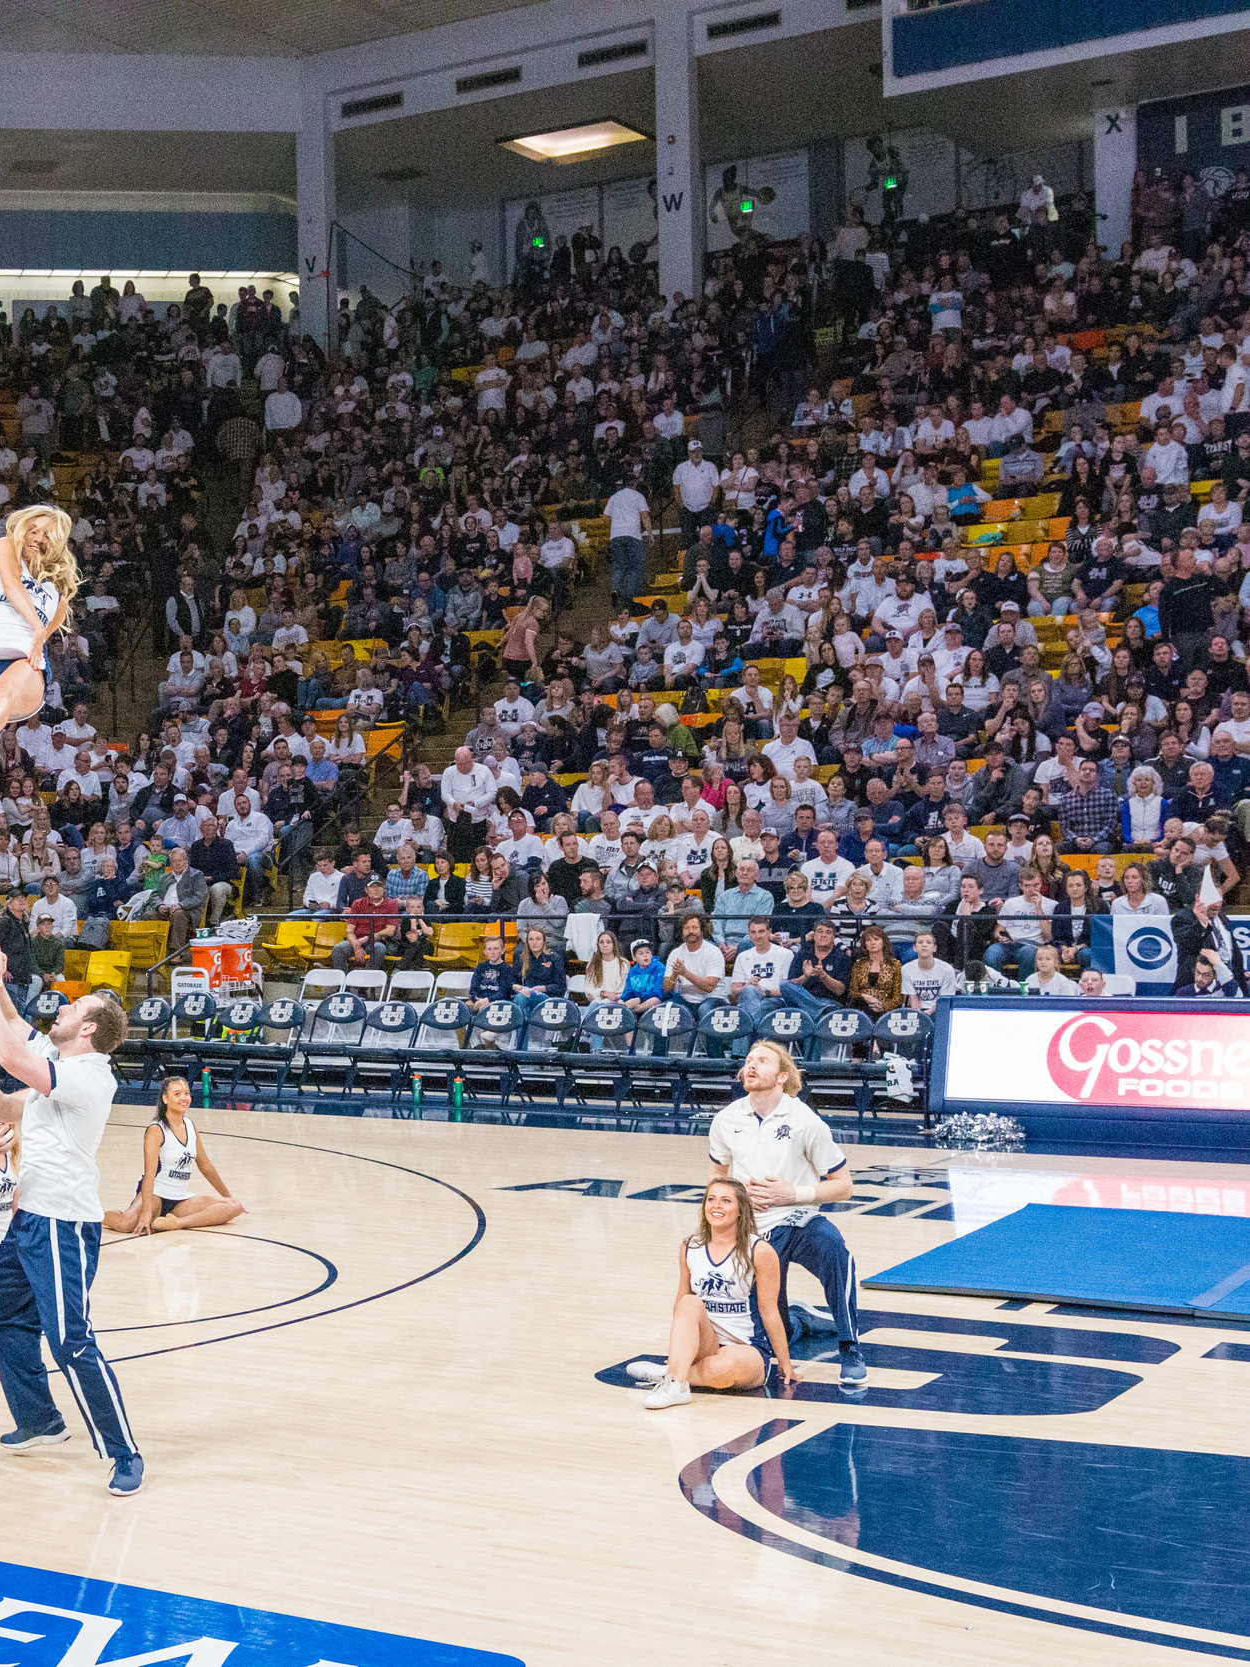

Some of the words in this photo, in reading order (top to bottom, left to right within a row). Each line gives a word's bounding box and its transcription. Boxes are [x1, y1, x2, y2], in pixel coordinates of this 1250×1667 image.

[1105, 113, 1122, 135] X
[662, 192, 684, 212] W
[304, 256, 316, 273] V
[745, 701, 757, 715] A
[811, 878, 838, 886] STATE
[751, 967, 775, 975] STATE
[1059, 1016, 1250, 1098] Gossne
[1118, 1078, 1245, 1100] FOODS
[719, 1302, 746, 1313] STATE
